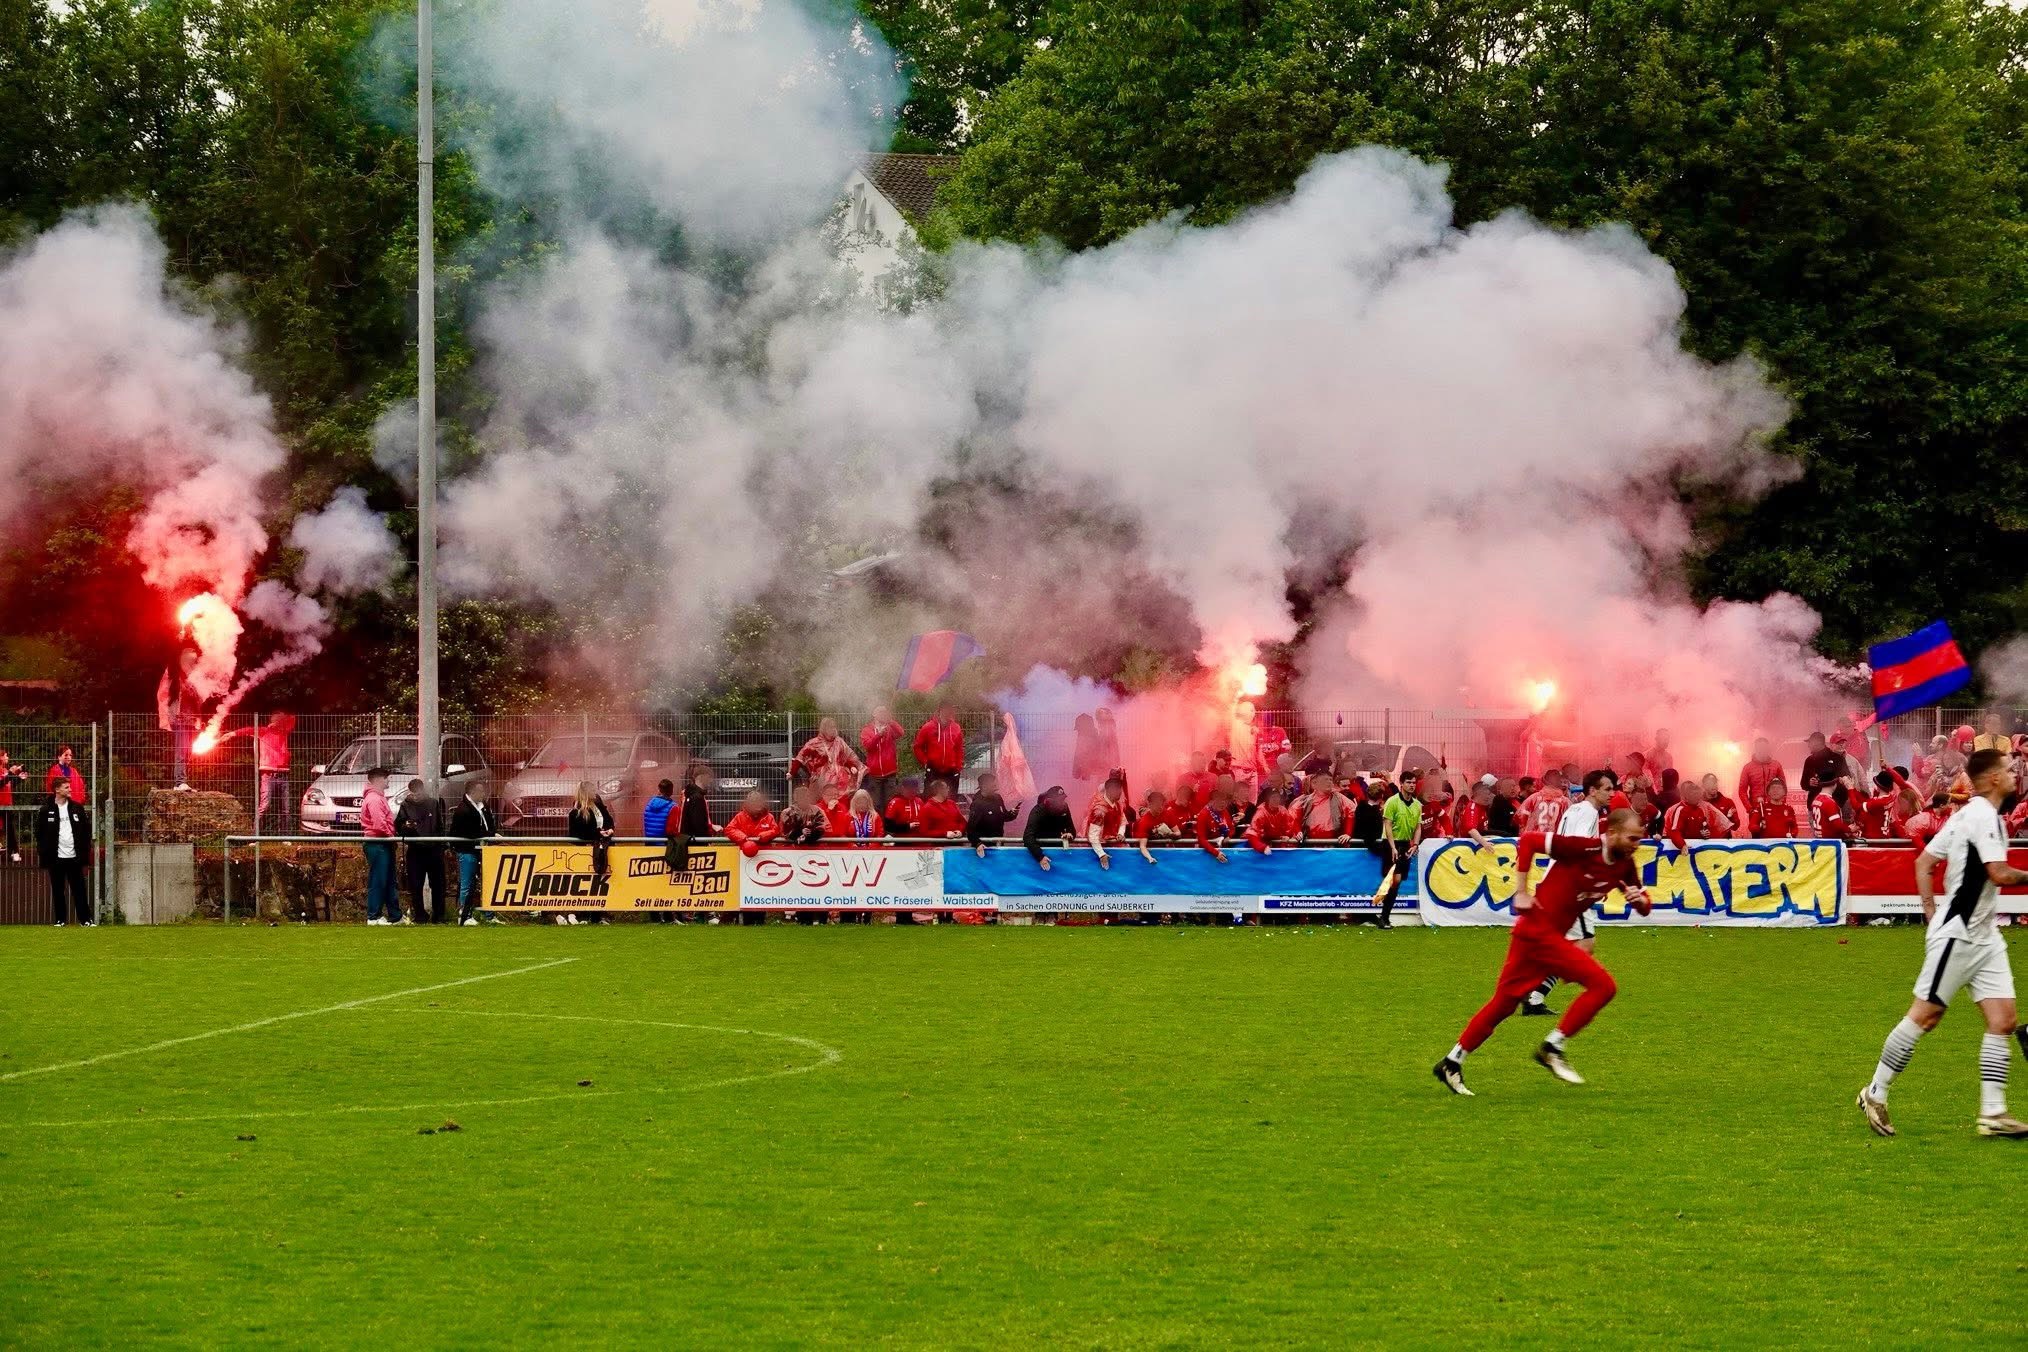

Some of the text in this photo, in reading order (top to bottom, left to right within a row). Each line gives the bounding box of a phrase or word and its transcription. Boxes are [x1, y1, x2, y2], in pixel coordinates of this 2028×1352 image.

[630, 856, 715, 875] Kompenz
[745, 853, 888, 888] GSW
[490, 854, 613, 907] HAUCK
[672, 871, 693, 883] am
[692, 874, 728, 894] Bau
[526, 897, 606, 908] Bauunternehmung
[634, 898, 725, 908] Seit über 150 Jahren
[744, 895, 994, 906] Maschinenbau GmbH CNC Fräserei Waibstadt
[1006, 902, 1155, 910] in Sachen ORDNUNG und SAUBERKEIT
